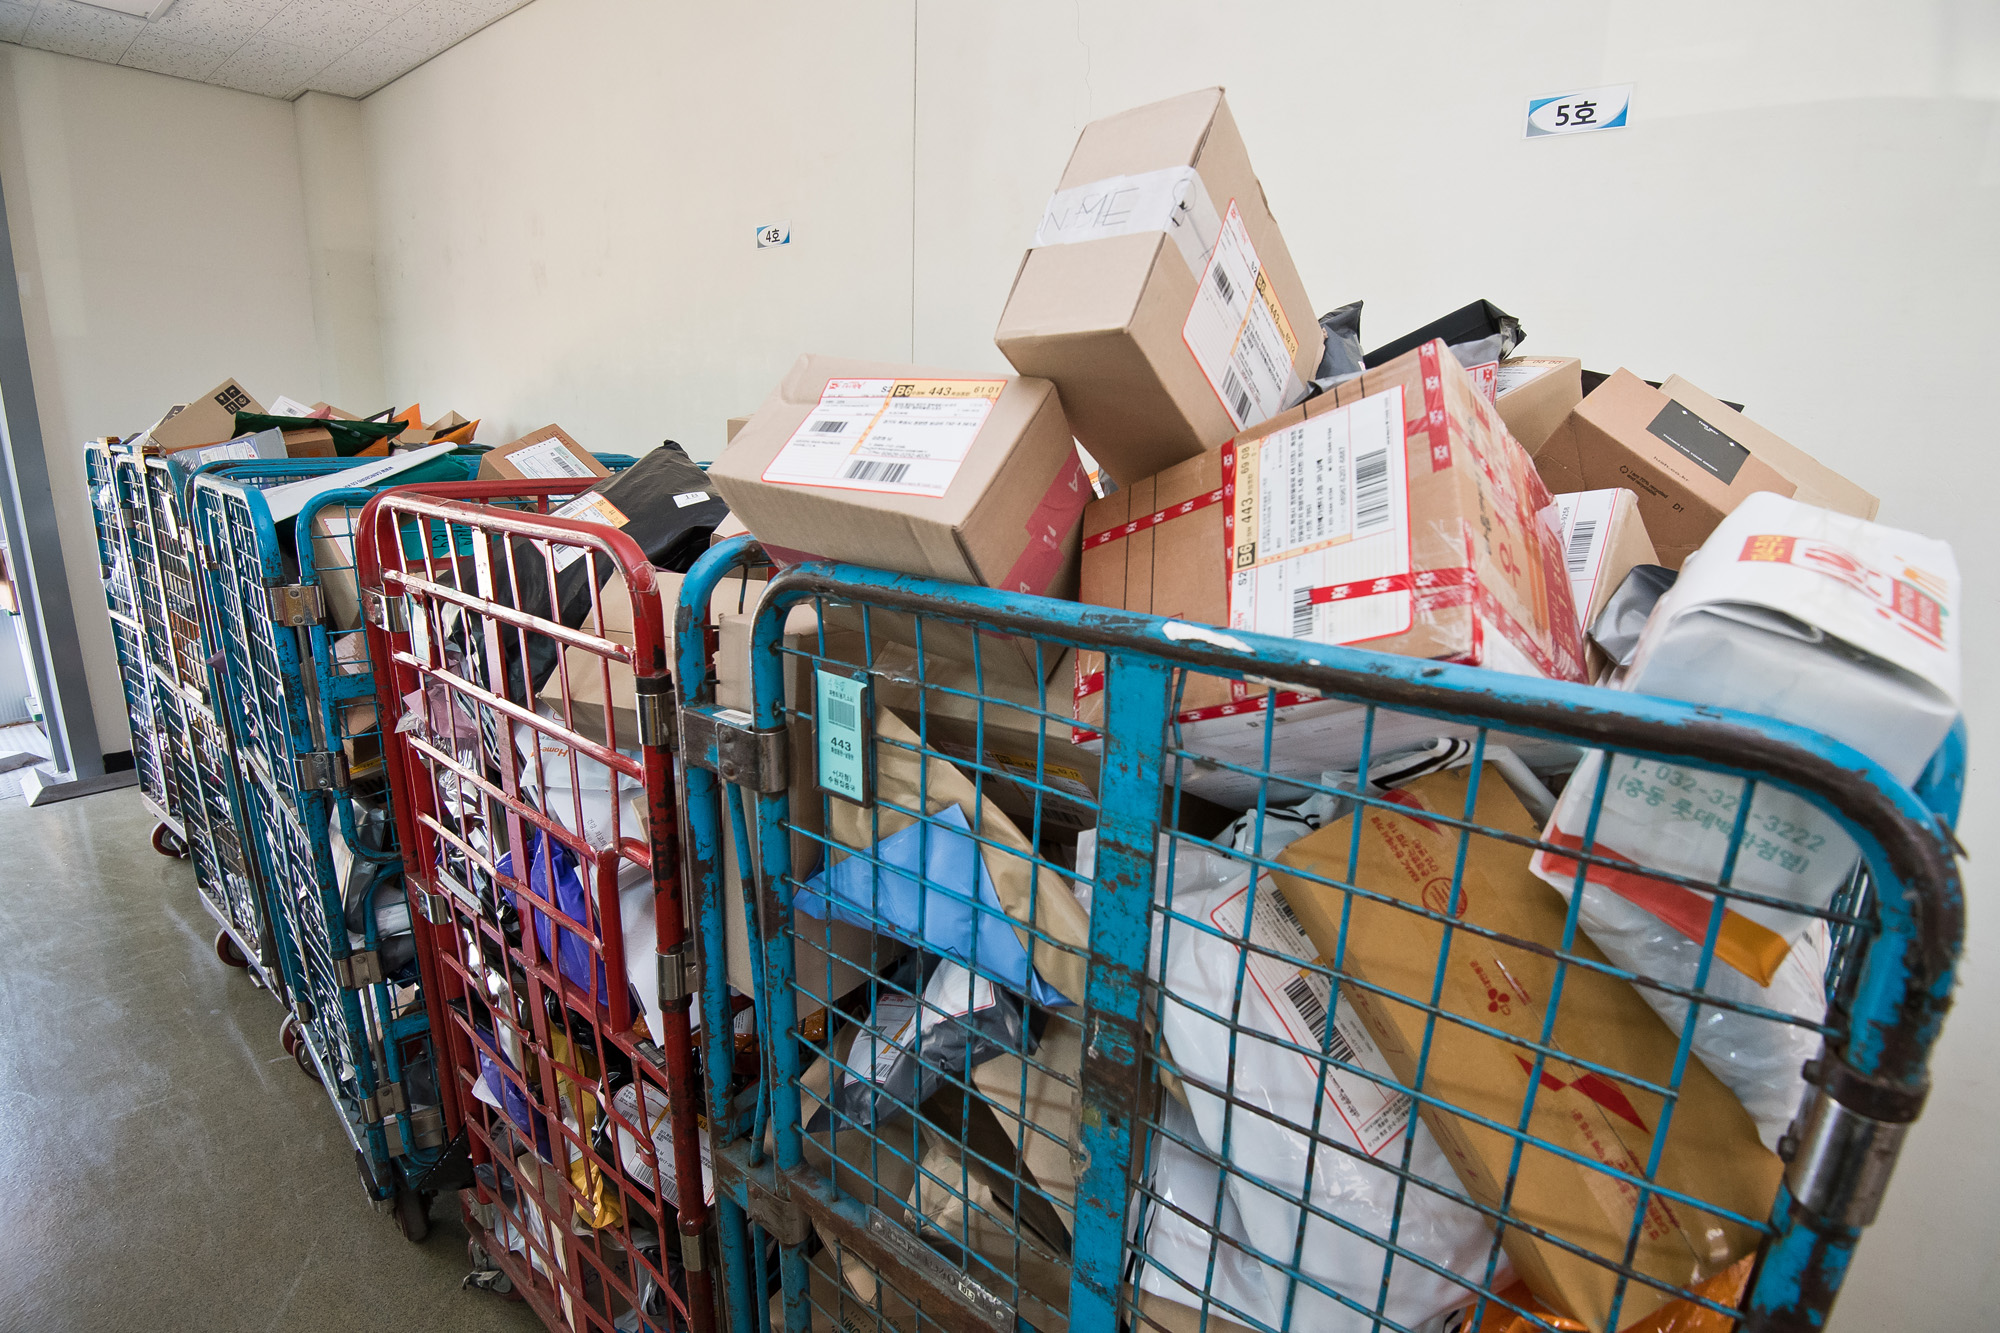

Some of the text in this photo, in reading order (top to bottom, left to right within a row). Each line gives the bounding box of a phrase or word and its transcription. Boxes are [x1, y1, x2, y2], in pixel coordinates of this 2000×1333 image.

[1555, 100, 1597, 127] 5호
[765, 228, 780, 243] 4호
[1268, 303, 1281, 326] 443
[894, 385, 913, 397] B6
[928, 386, 952, 397] 443
[973, 385, 987, 394] 61
[1240, 445, 1250, 460] 08
[1240, 460, 1249, 475] 69
[1240, 496, 1253, 524] 443
[1671, 501, 1685, 514] D1
[1237, 542, 1254, 567] B6
[1237, 570, 1247, 586] S2
[830, 736, 852, 752] 443
[827, 776, 856, 792] 수원집중국
[1654, 762, 1826, 853] 032-32-3222
[1395, 833, 1410, 849] 기업
[1370, 815, 1421, 884] KMAC 한국에서 가장
[1406, 847, 1431, 878] 존경받는
